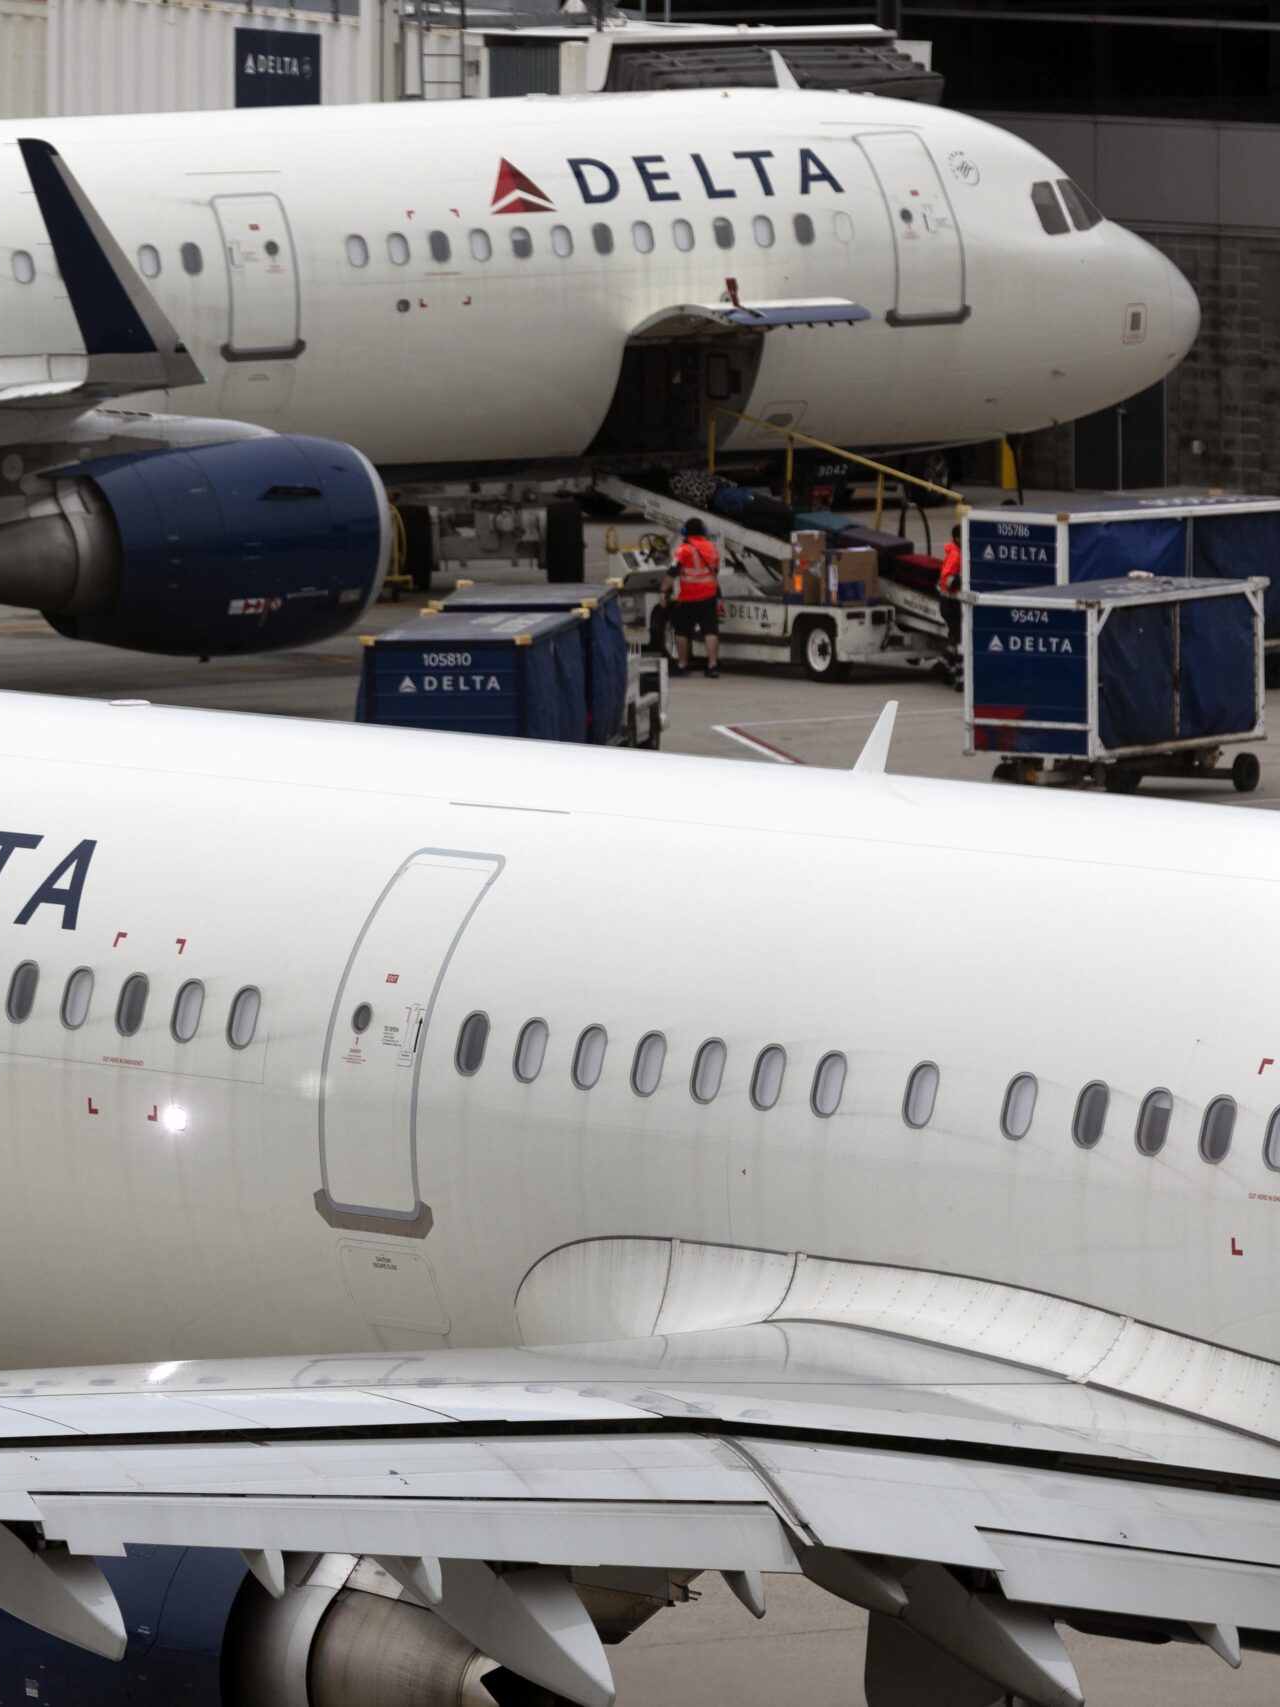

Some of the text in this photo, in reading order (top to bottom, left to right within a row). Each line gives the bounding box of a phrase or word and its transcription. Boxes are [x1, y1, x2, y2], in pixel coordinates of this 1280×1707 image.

[257, 54, 300, 76] DELTA
[568, 148, 844, 205] DELTA
[998, 545, 1048, 561] DELTA
[729, 604, 769, 621] DELTA
[1011, 609, 1049, 624] 95474
[1009, 635, 1073, 653] DELTA
[422, 652, 472, 667] 105810
[423, 676, 501, 691] DELTA
